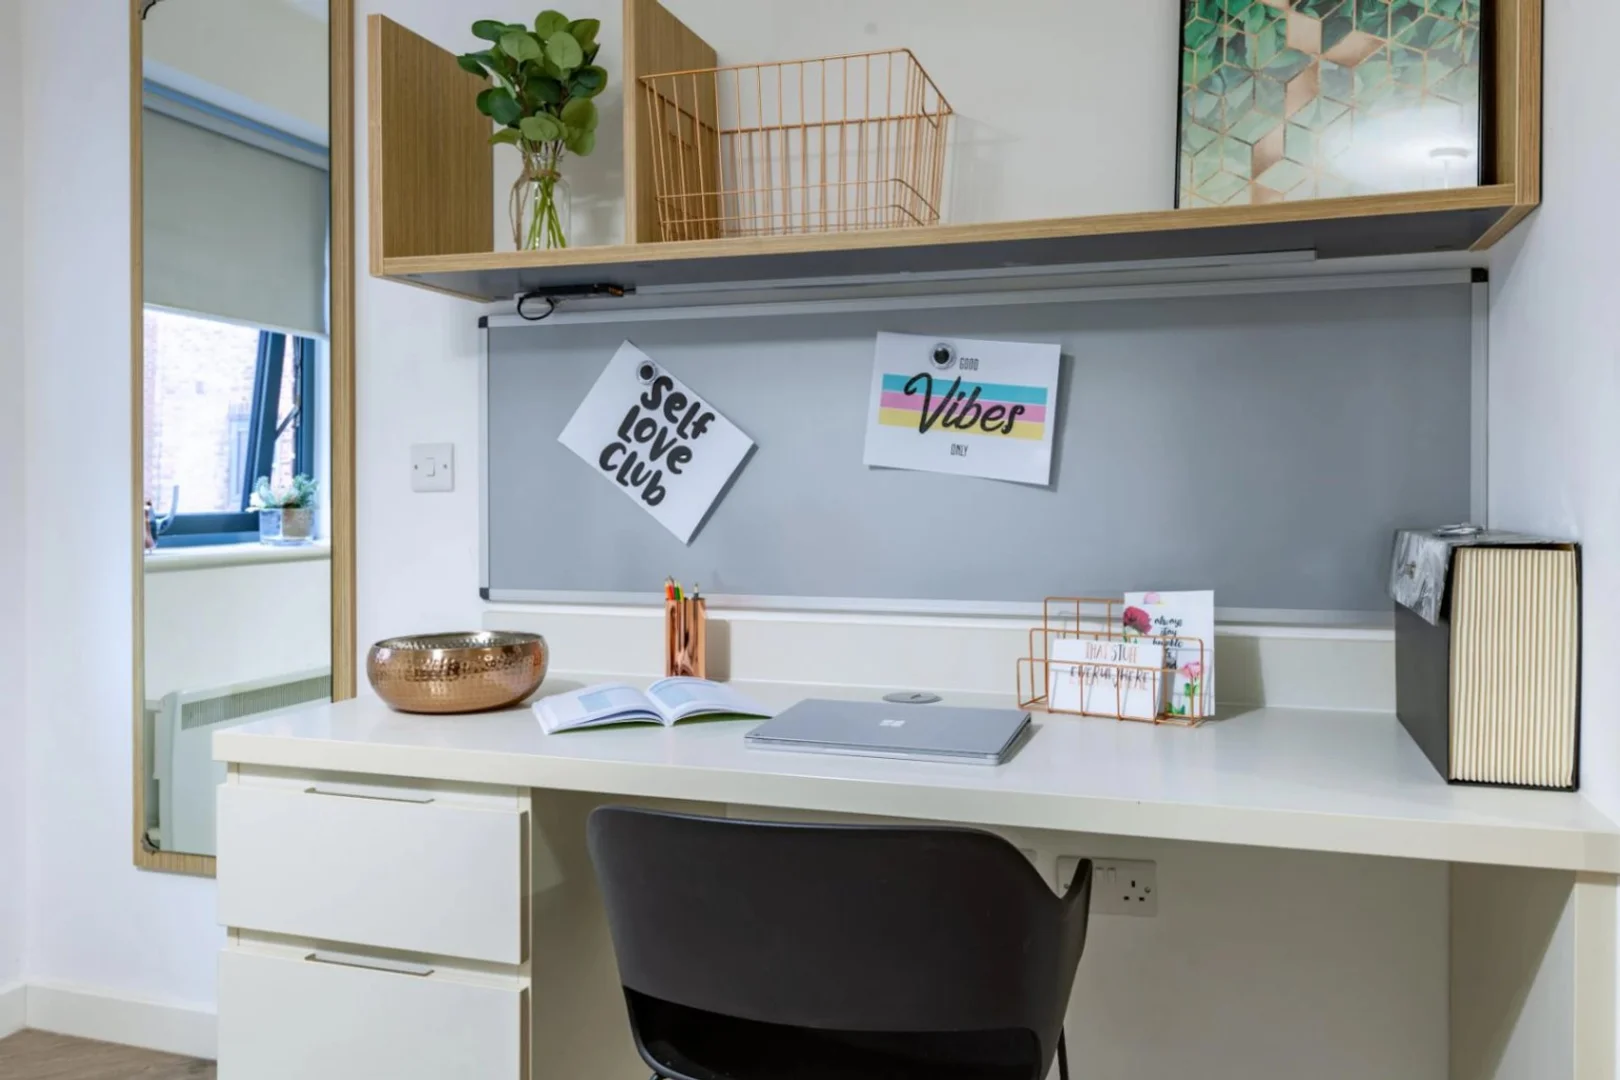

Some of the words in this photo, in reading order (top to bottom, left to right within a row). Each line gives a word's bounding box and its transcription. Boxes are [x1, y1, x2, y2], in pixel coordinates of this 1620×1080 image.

[959, 357, 980, 371] GOOD
[903, 372, 1026, 435] Vibes
[950, 443, 969, 457] ONLY
[1085, 642, 1108, 660] THAT
